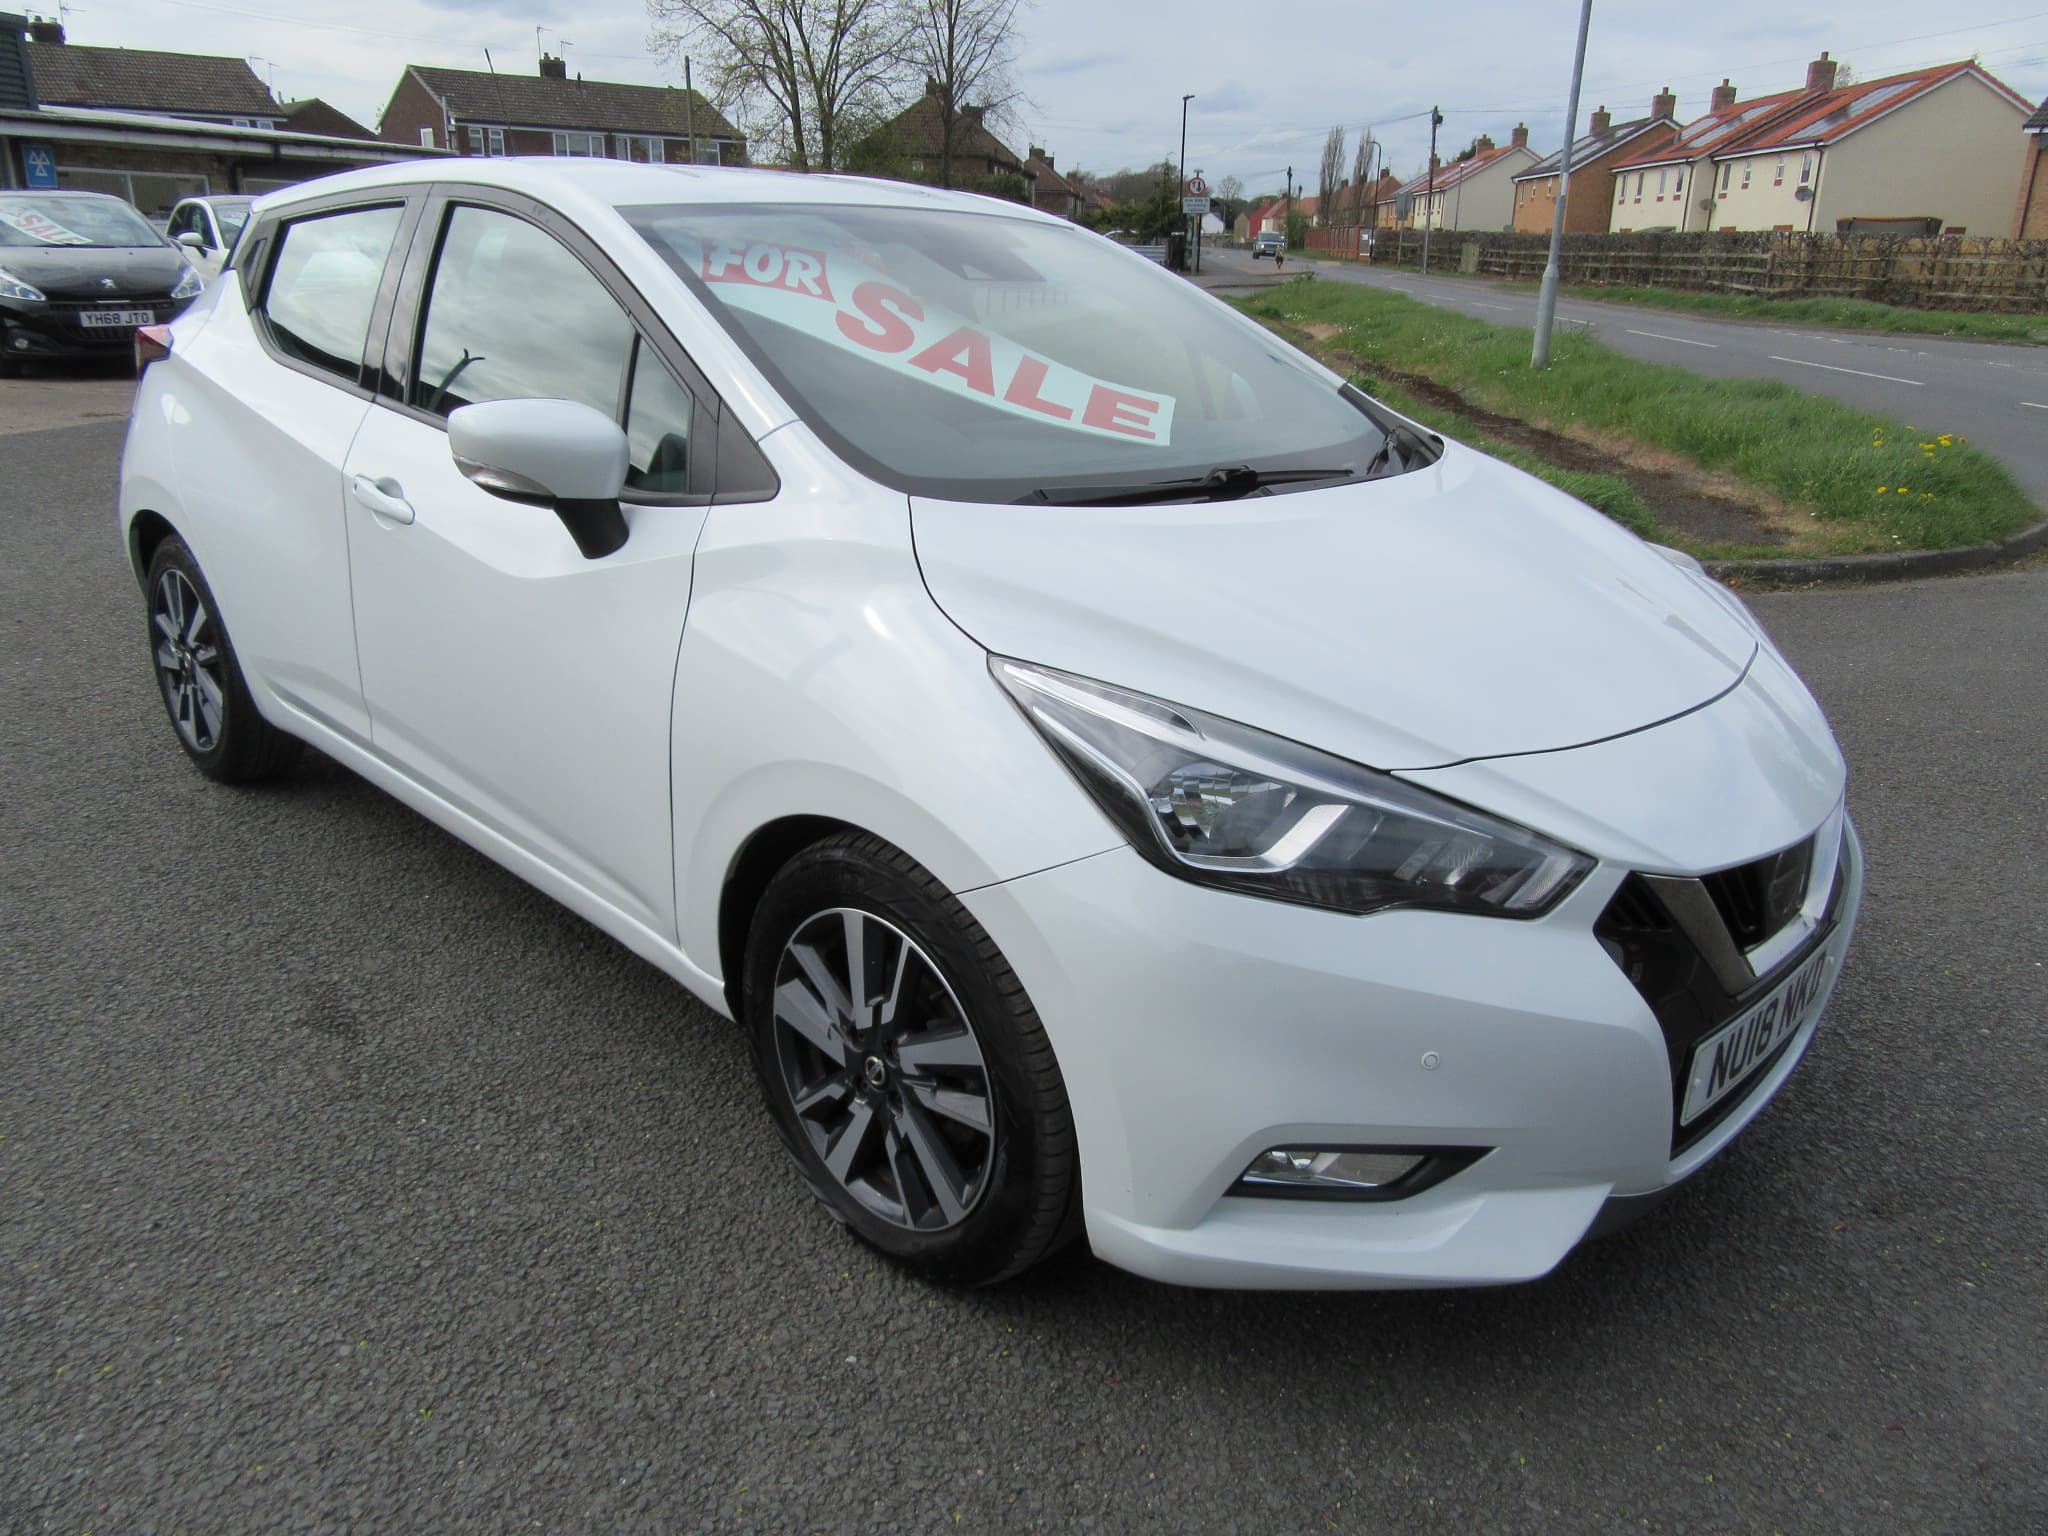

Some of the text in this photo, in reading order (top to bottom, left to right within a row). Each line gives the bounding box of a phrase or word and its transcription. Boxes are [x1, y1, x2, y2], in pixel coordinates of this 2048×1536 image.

[86, 313, 120, 324] YH68
[706, 239, 1159, 440] FOR SALE
[1706, 997, 1779, 1099] NU18
